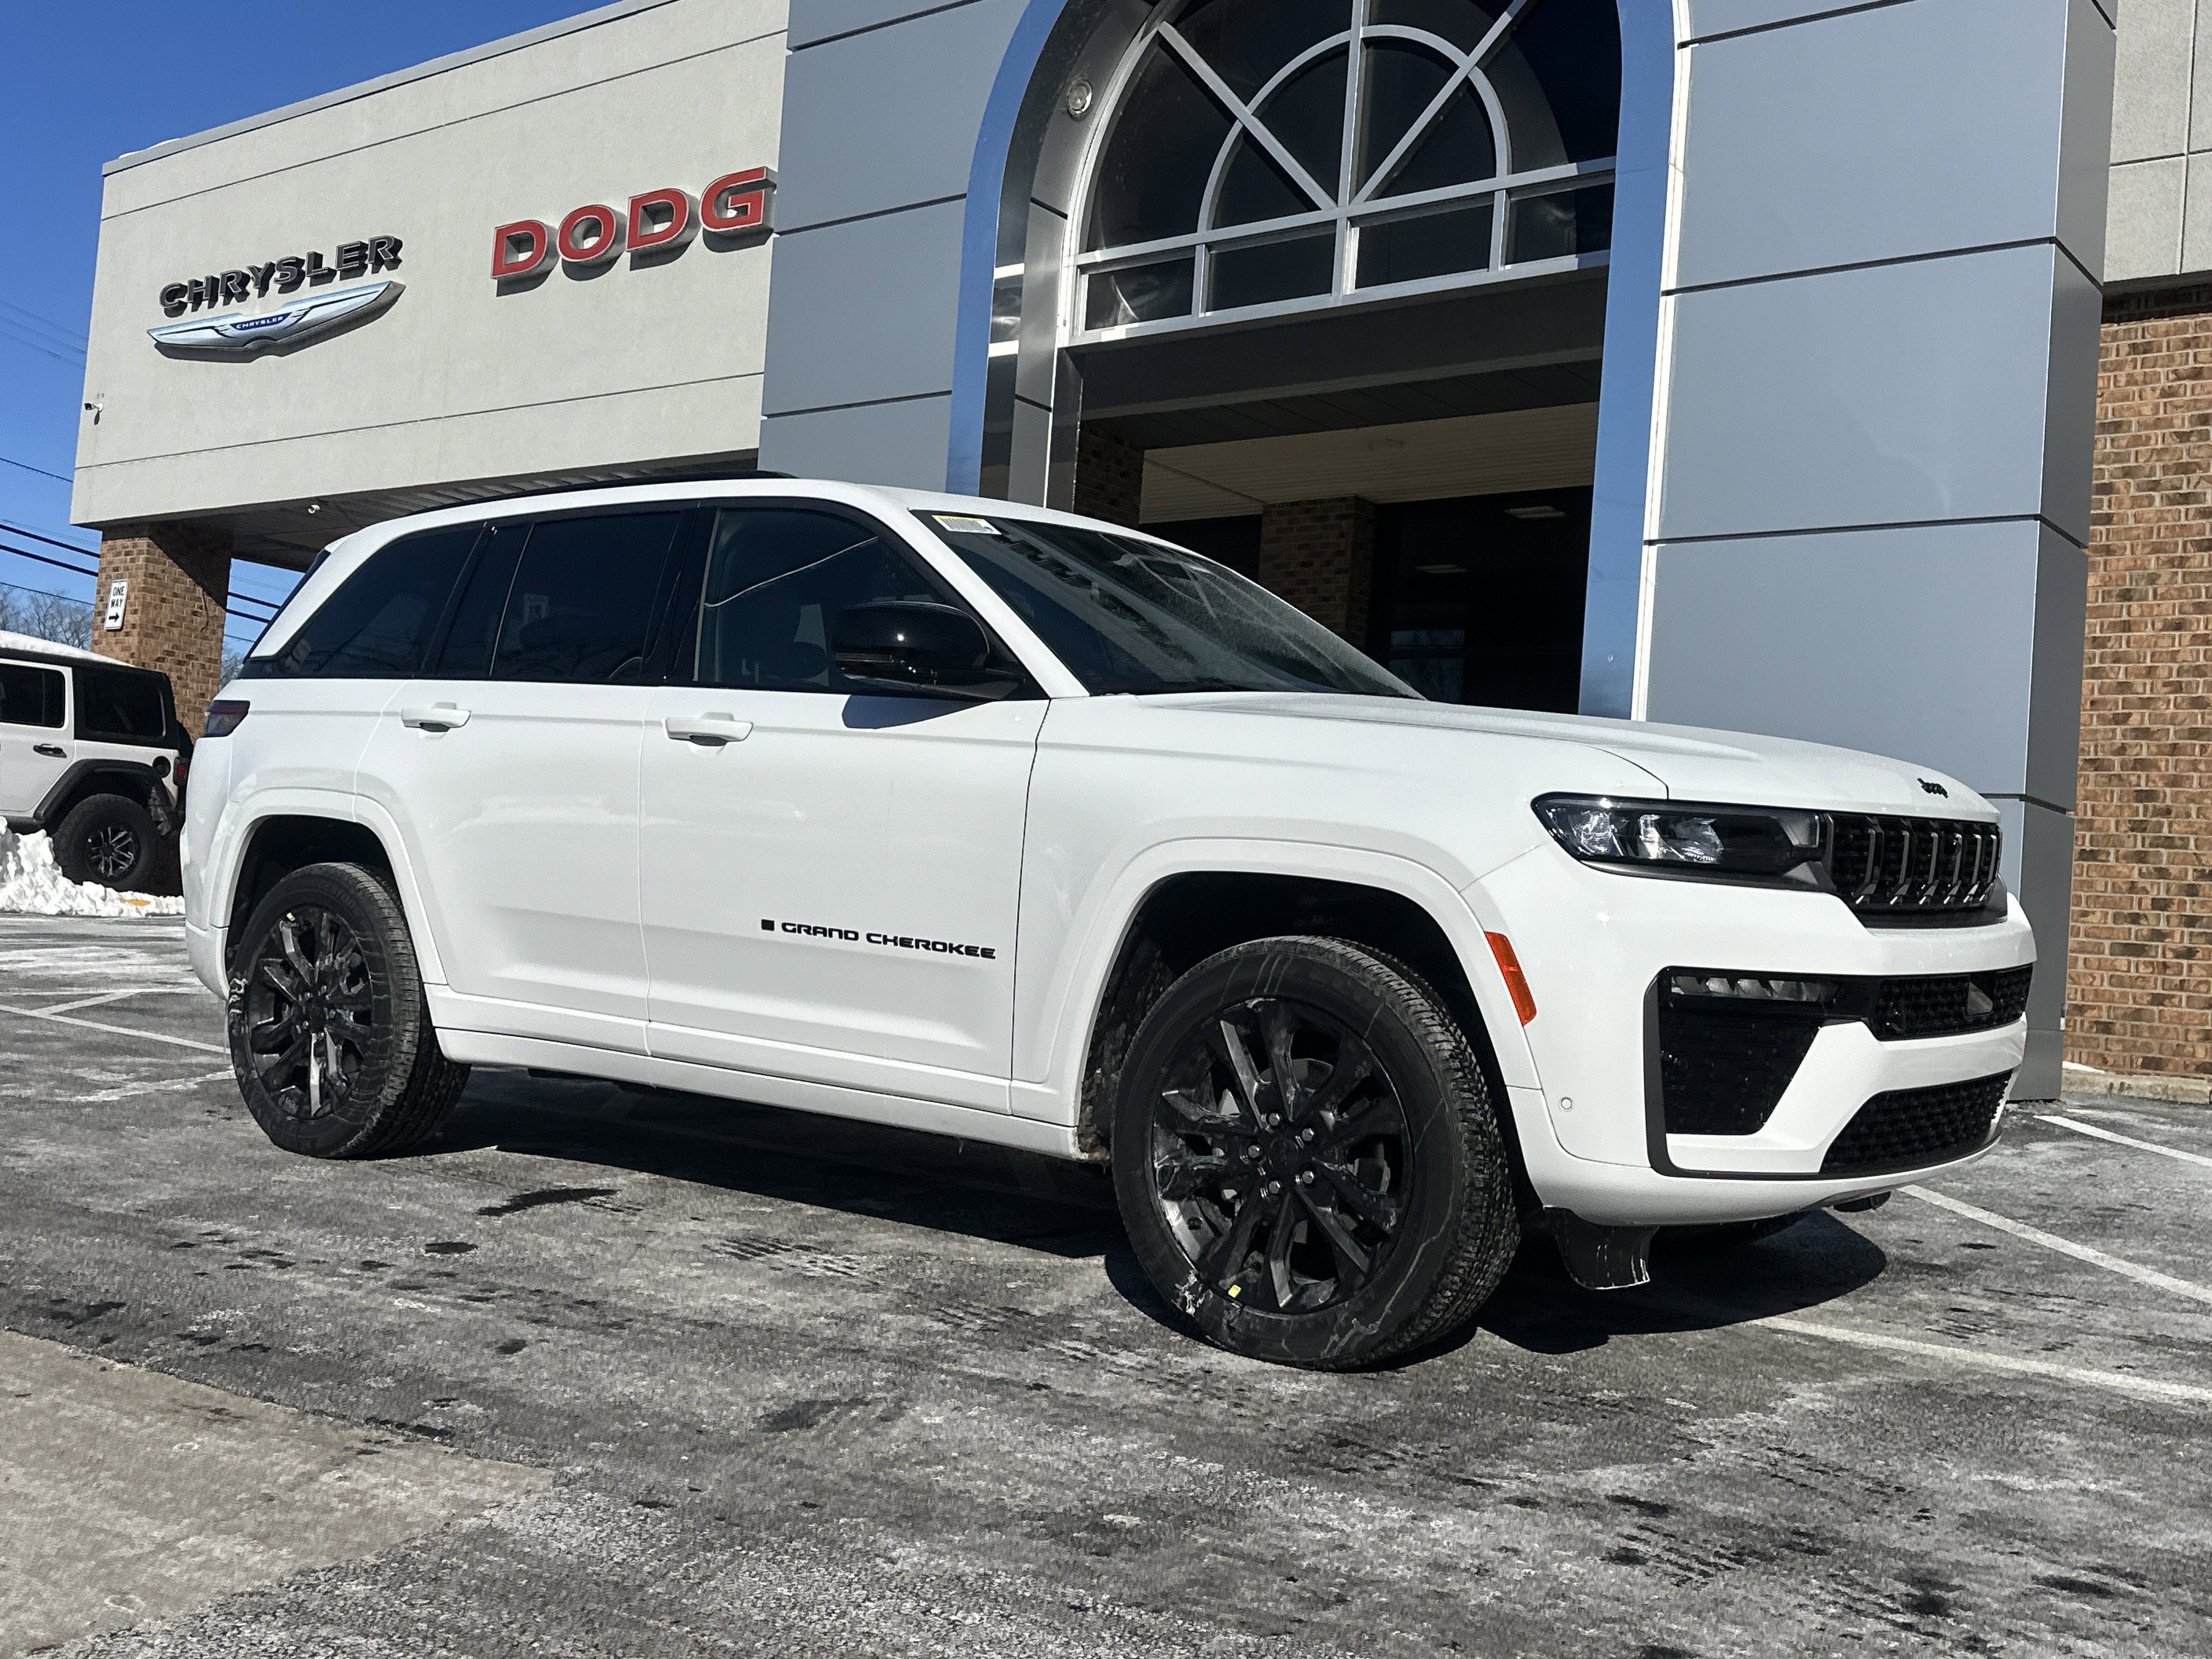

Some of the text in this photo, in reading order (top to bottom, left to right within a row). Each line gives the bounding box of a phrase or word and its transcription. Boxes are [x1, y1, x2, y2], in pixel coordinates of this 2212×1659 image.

[159, 235, 400, 314] CHRYSLER
[236, 316, 283, 329] CHRYSLER
[111, 598, 123, 608] WAY
[112, 585, 125, 596] ONE
[297, 877, 363, 917] RIDGESTONE
[781, 922, 996, 960] GRAND CHEROKEE
